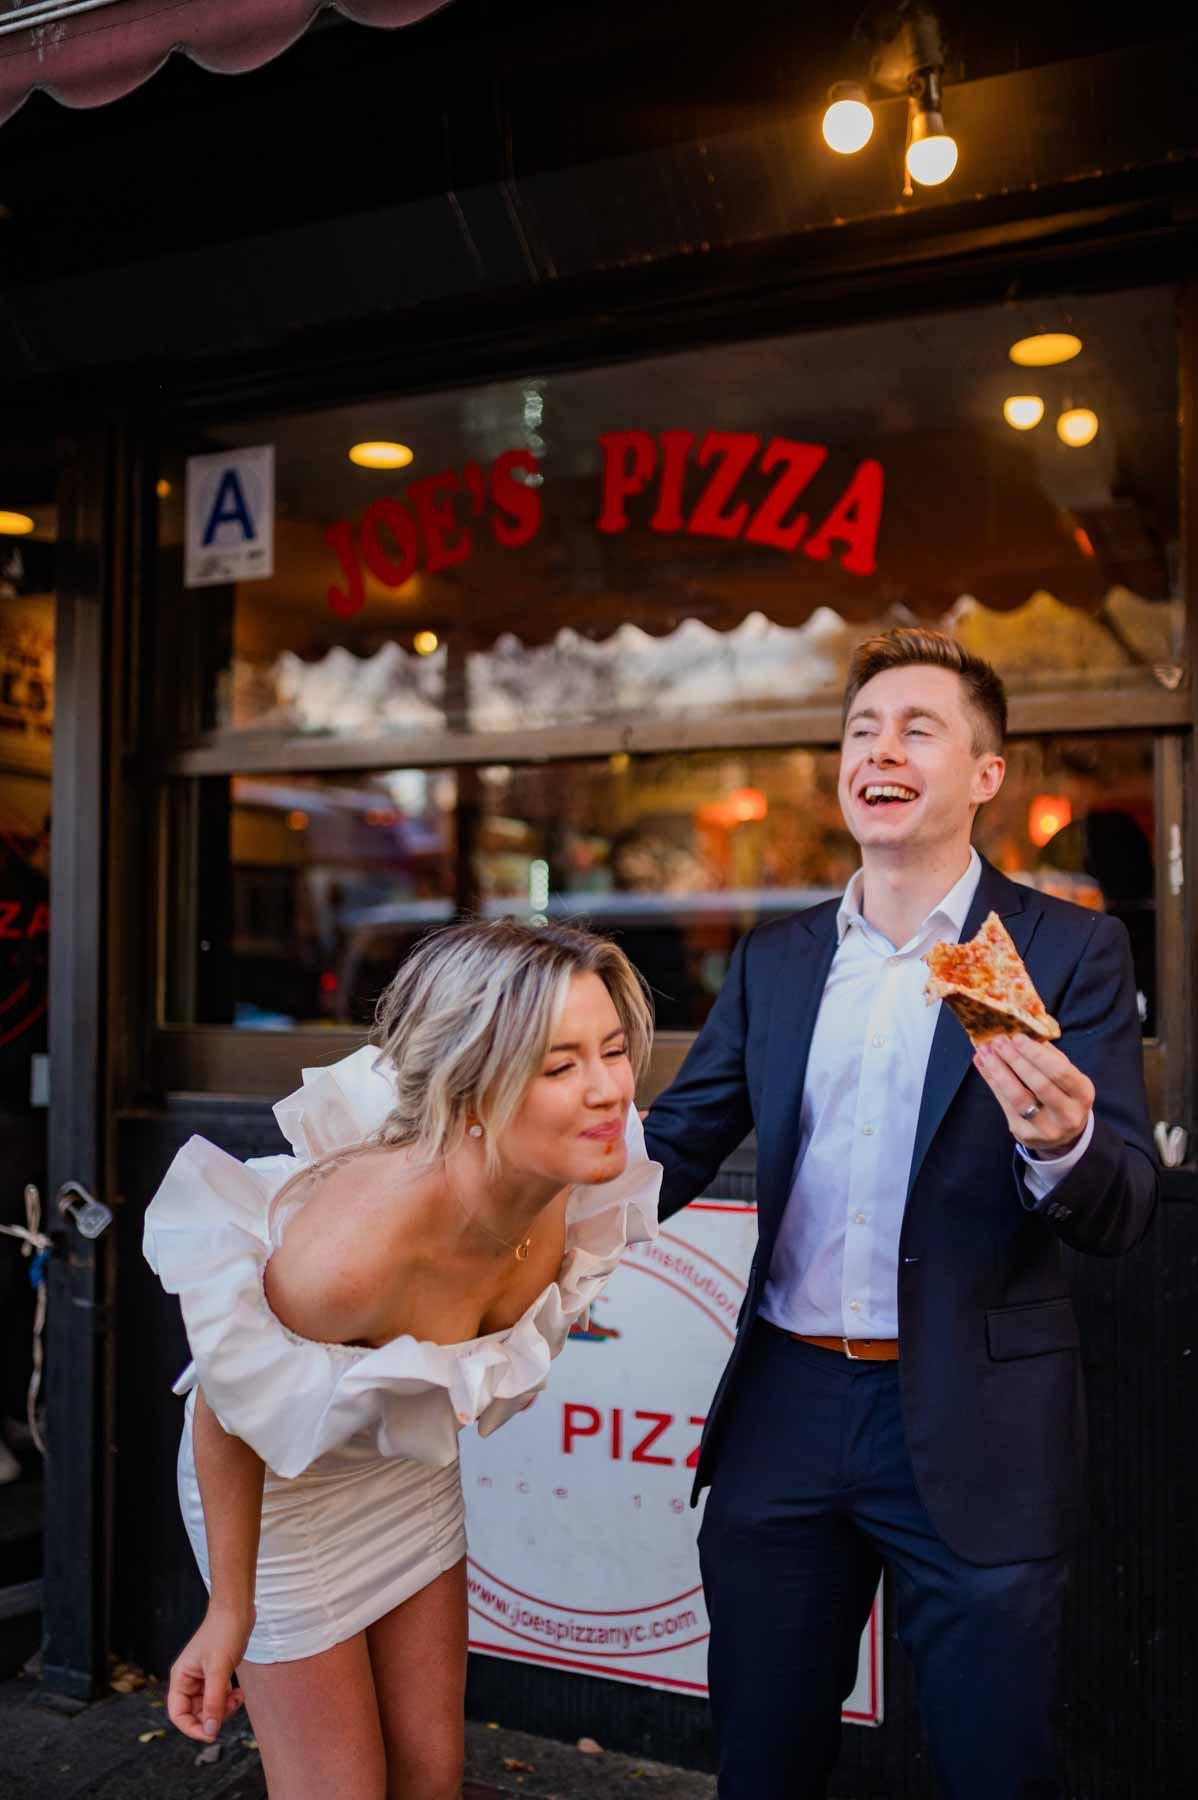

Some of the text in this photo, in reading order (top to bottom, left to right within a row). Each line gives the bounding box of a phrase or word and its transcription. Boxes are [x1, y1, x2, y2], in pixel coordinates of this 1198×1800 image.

[202, 468, 256, 547] A
[324, 429, 885, 617] JOE'S PIZZA
